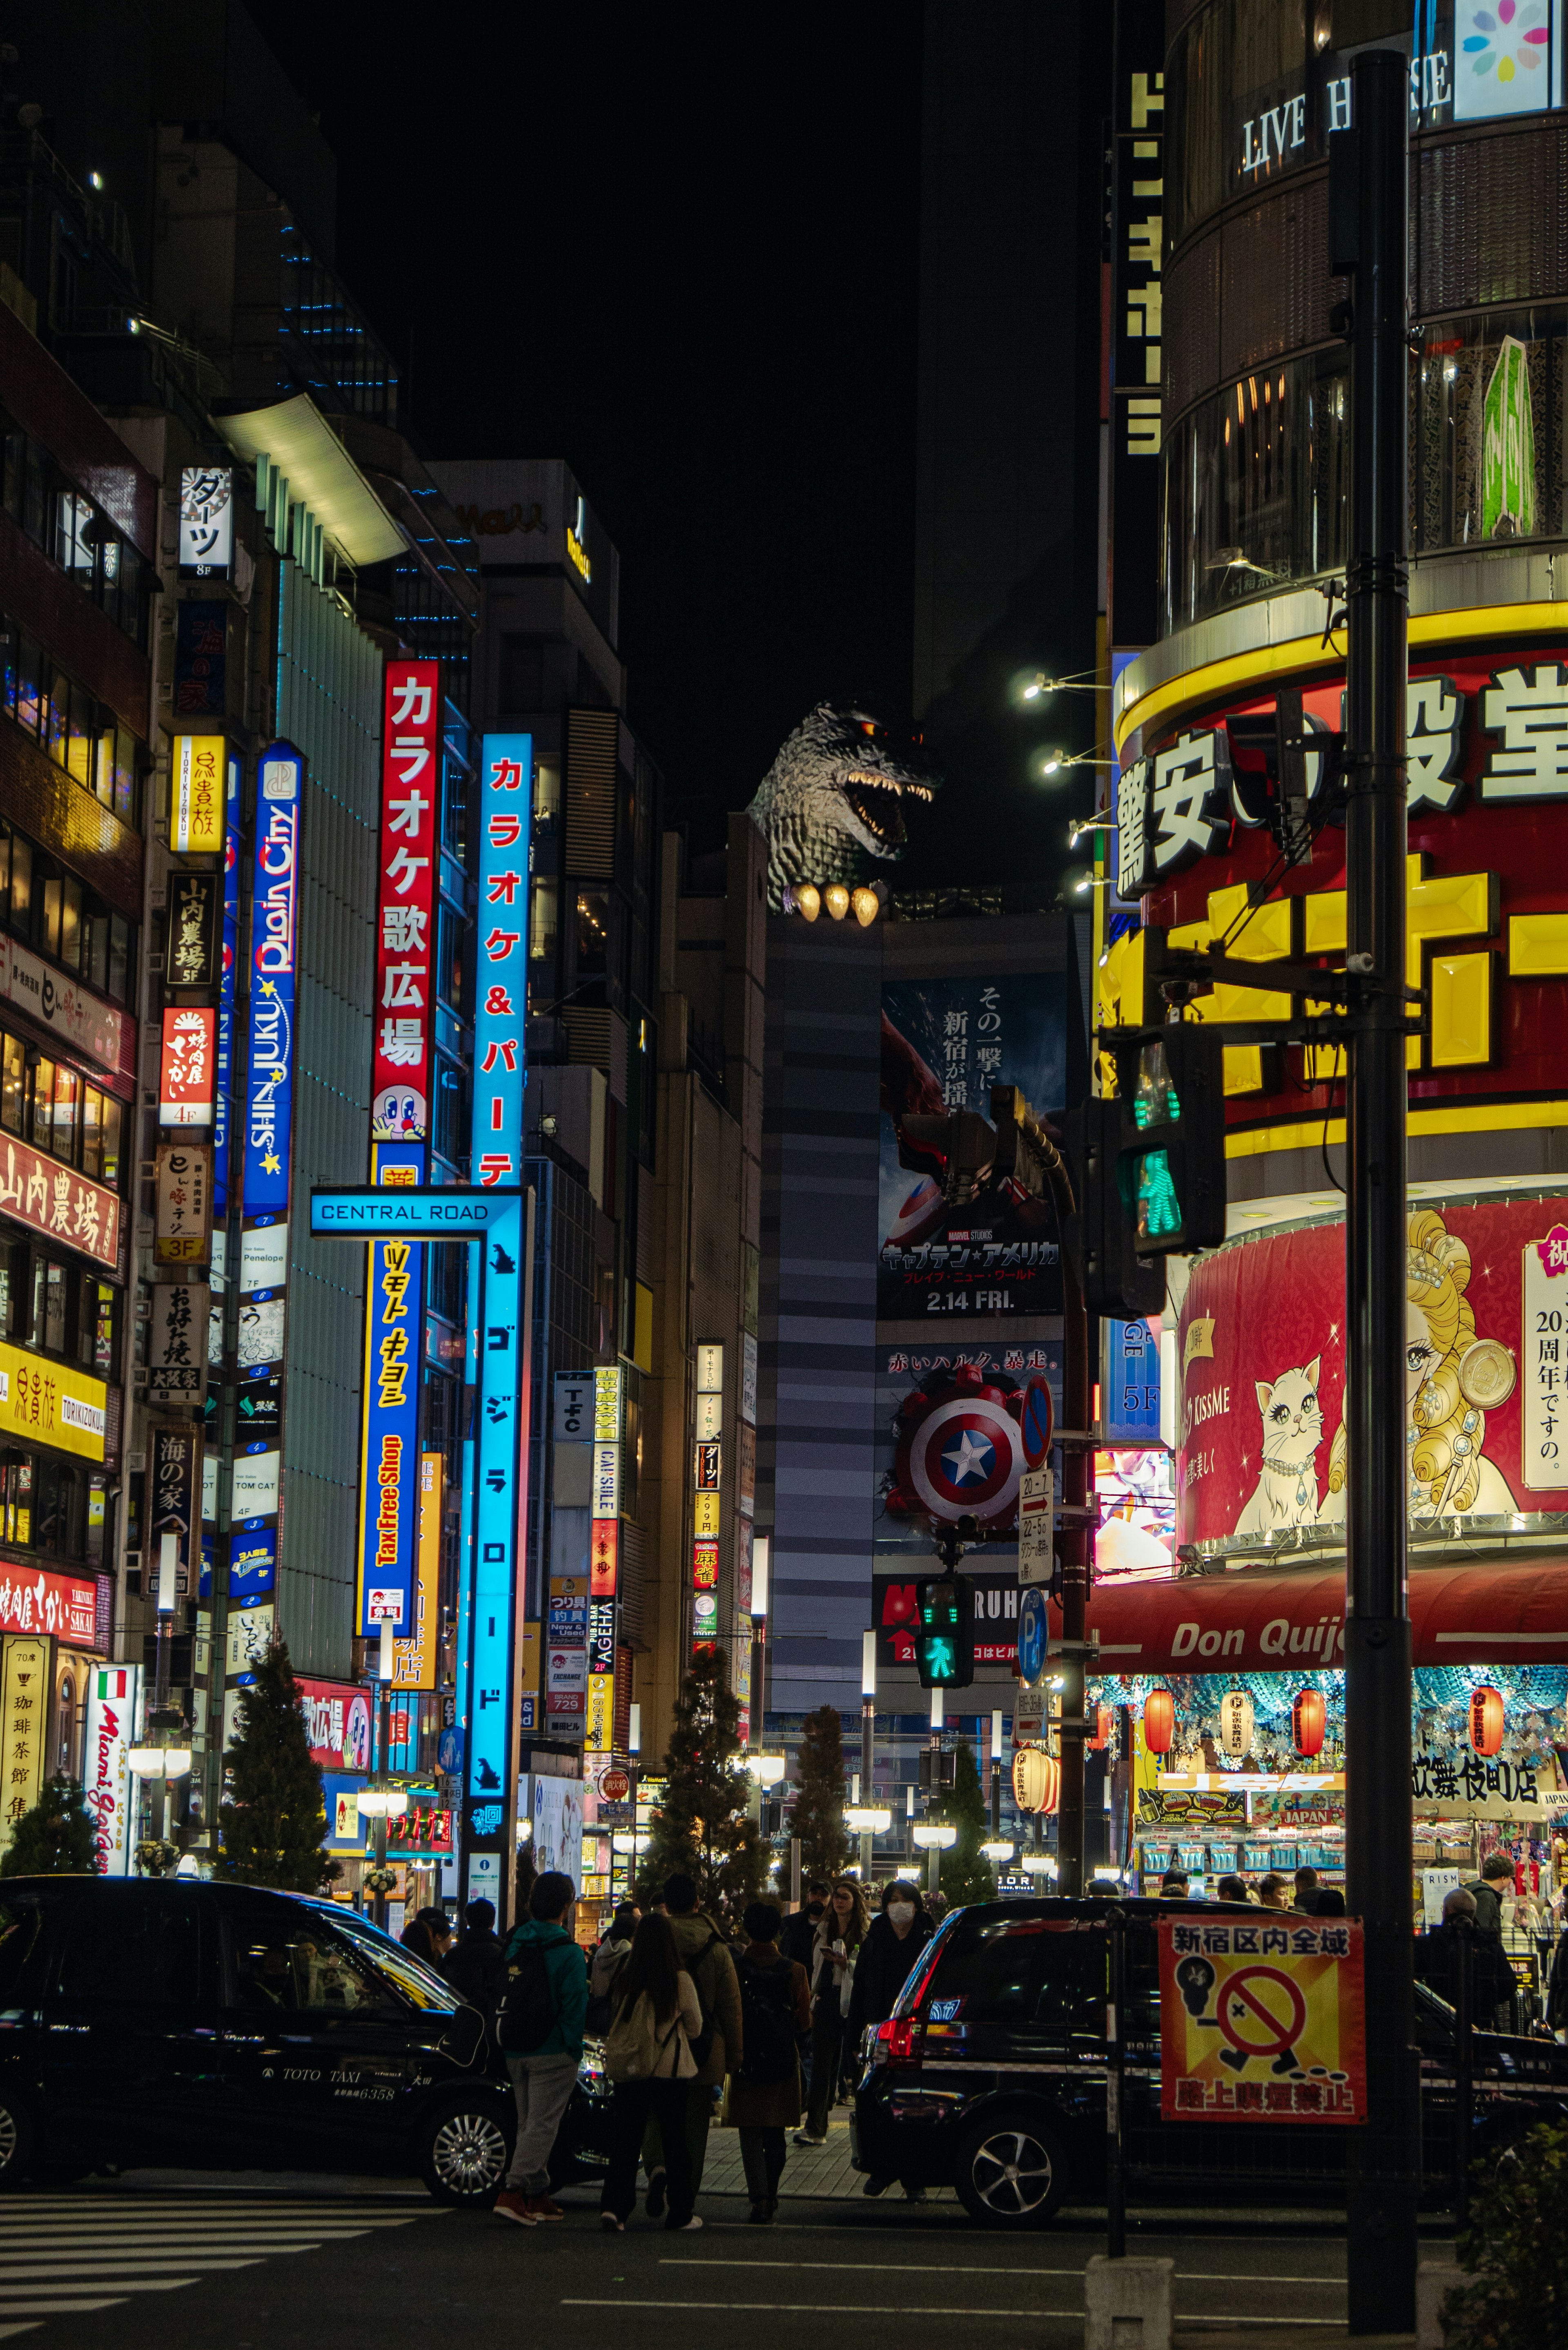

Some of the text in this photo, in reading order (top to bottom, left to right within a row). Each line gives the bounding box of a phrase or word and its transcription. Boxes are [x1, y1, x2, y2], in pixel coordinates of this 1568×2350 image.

[1243, 51, 1452, 172] LIVE HSE
[189, 473, 220, 556] ダーツ
[196, 564, 211, 575] 8F
[177, 619, 224, 712] 海の家
[180, 751, 189, 831] TORIKIZOKU
[379, 677, 432, 1067] カラオケ歌広場
[175, 878, 207, 968] 山内農場
[183, 970, 198, 981] 5F
[976, 987, 1002, 1090] その一撃に
[166, 1035, 187, 1099] さかい
[186, 1030, 208, 1085] 焼肉屋
[251, 1002, 287, 1148] SHINJUKU
[174, 1105, 196, 1123] 4F
[0, 1143, 99, 1252] 山内農場
[322, 1205, 488, 1220] CENTRAL ROAD
[169, 1240, 194, 1257] 3F
[948, 1230, 993, 1241] MARVEL STUDIOS
[927, 1290, 1014, 1310] 2.14 FRI.
[380, 1241, 410, 1408] ツモトキヨシ
[596, 1370, 617, 1379] 新宿
[1536, 1311, 1563, 1469] 20周年ですの。
[63, 1399, 100, 1430] TORIKIZOKU
[160, 1437, 185, 1510] 海の家
[599, 1451, 615, 1510] CAPSULE
[706, 1447, 718, 1480] ダーツ
[376, 1435, 403, 1567] Tax Free Shop
[1024, 1474, 1047, 1495] 20-7
[479, 1325, 515, 1710] ゴジラロード
[695, 1550, 717, 1583] 麻雀
[71, 1588, 94, 1605] YAKINIKU
[551, 1596, 586, 1608] つり具
[70, 1610, 93, 1633] SAKAI
[597, 1602, 612, 1663] AGEHA
[1024, 1612, 1036, 1669] P
[1170, 1623, 1245, 1657] Don
[16, 1653, 36, 1662] 70席
[554, 1700, 578, 1710] 729
[1232, 1711, 1242, 1749] 新宿歌舞伎町
[1473, 1707, 1484, 1748] 新宿歌舞伎町
[96, 1703, 120, 1790] Miami
[605, 1780, 626, 1791] 消火栓
[1285, 1810, 1327, 1824] JAPAN
[1173, 1925, 1349, 1956] 新宿区内全域
[283, 2068, 321, 2081] TOTO
[330, 2070, 361, 2083] TAXI
[360, 2088, 395, 2101] 6358
[1176, 2080, 1354, 2114] 路上喫煙禁止
